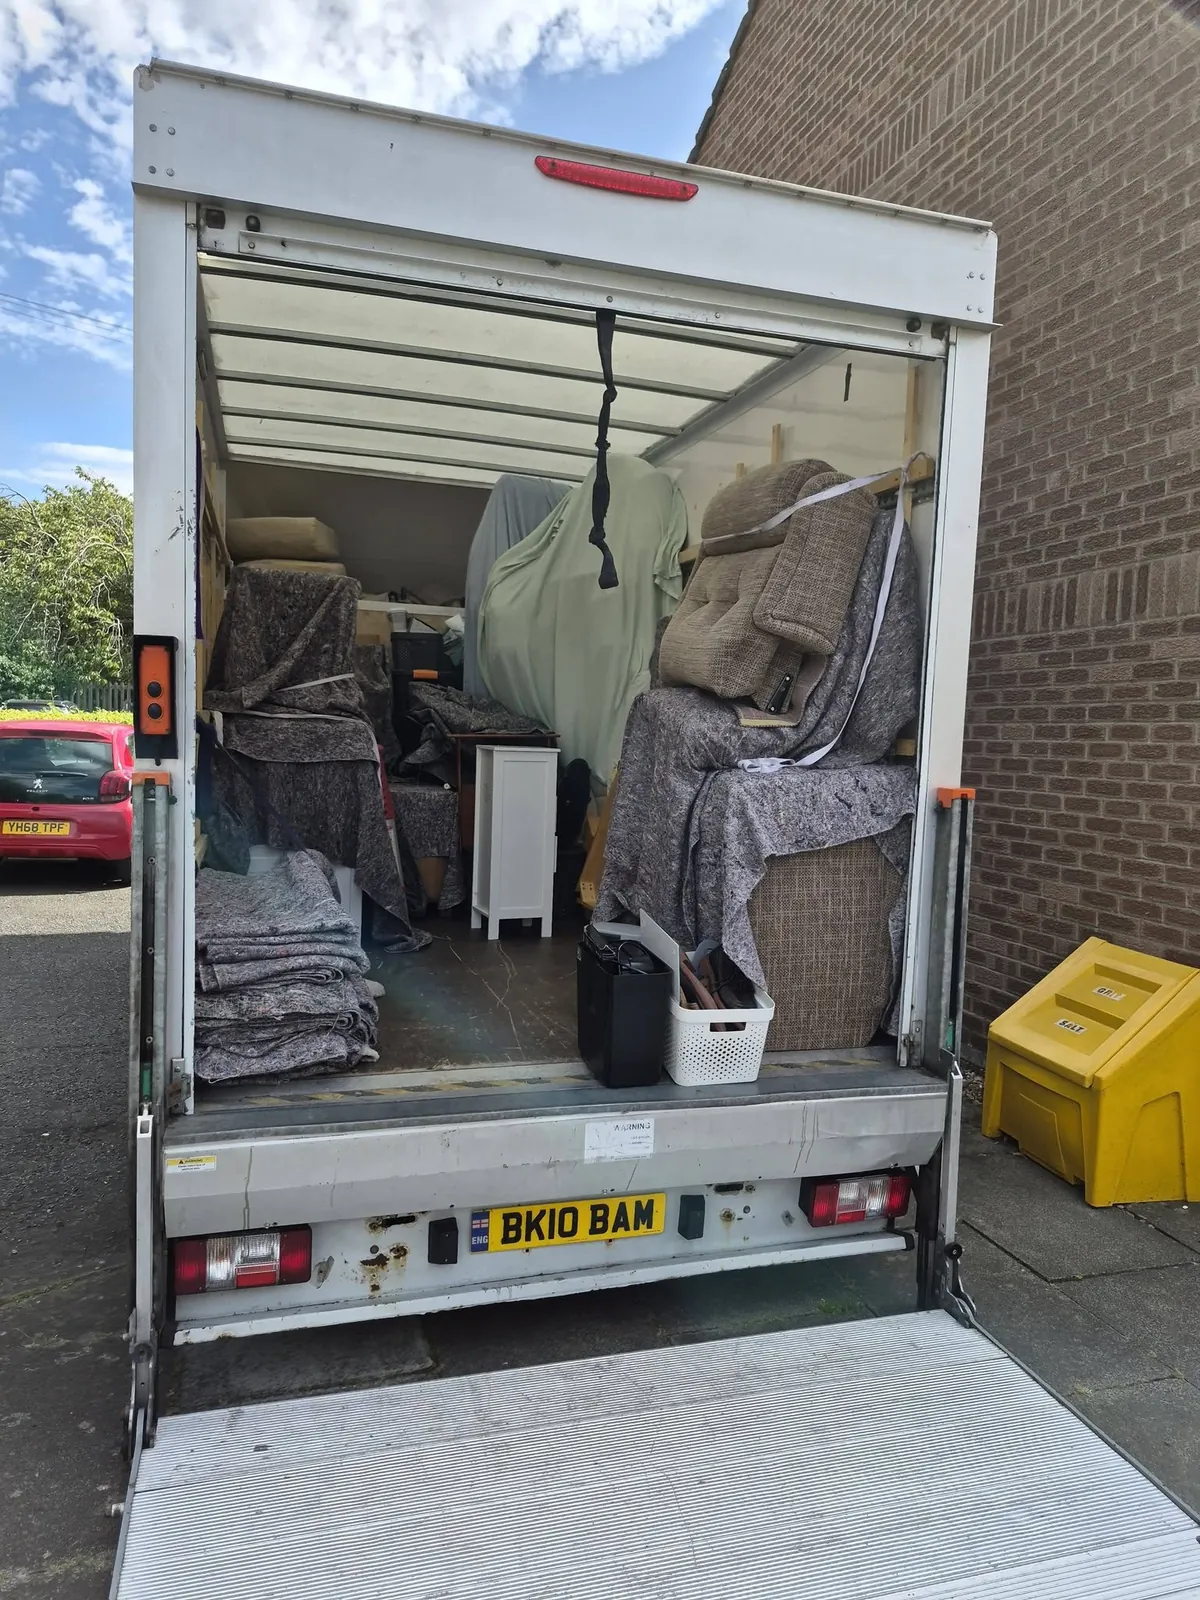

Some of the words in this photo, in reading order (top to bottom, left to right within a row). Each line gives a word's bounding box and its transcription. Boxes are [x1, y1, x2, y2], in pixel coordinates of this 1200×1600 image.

[8, 822, 39, 832] YH68
[43, 823, 64, 832] TPF
[1058, 1020, 1085, 1032] SALT
[613, 1122, 651, 1132] WARNING
[501, 1206, 578, 1244] BK10
[589, 1199, 654, 1235] BAM
[472, 1235, 488, 1245] ENG
